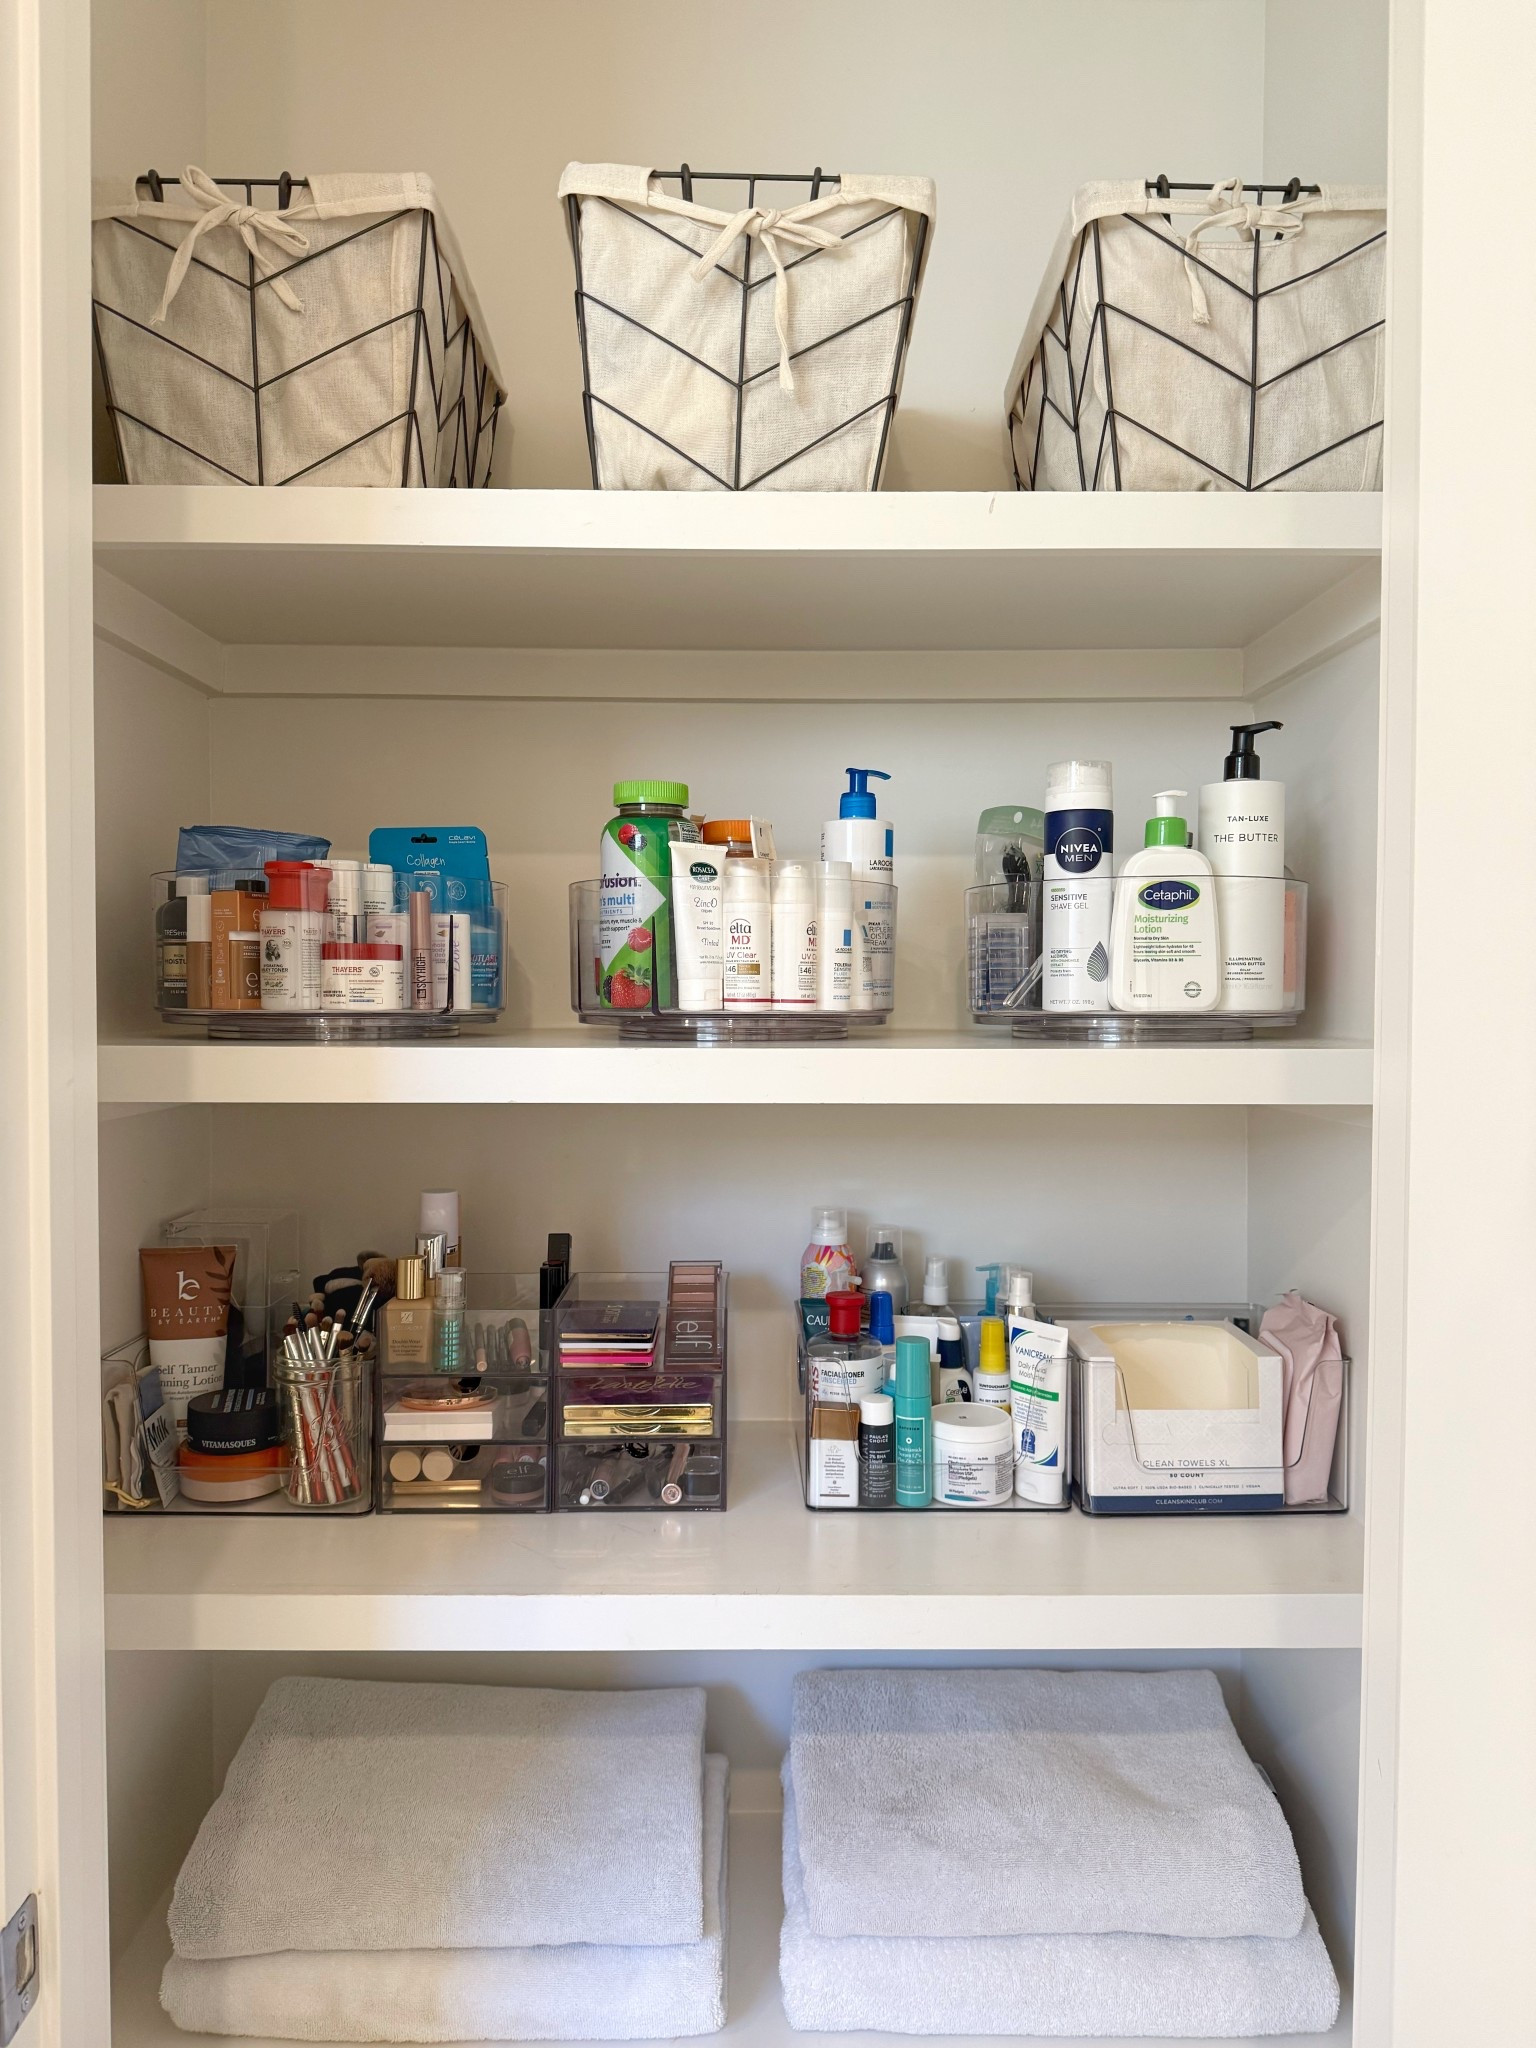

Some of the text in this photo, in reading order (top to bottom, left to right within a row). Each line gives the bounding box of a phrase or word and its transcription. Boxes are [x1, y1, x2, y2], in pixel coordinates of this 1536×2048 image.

[1213, 833, 1279, 843] THE BUTTER
[1060, 843, 1099, 853] NIVEA
[406, 853, 446, 868] Collagen
[1064, 854, 1093, 862] MEN
[607, 893, 635, 906] multi
[1050, 893, 1088, 901] SENSITIVE
[1143, 889, 1194, 902] Cetaphil
[1134, 914, 1189, 925] Moisturizing
[729, 922, 752, 934] elta
[1133, 924, 1162, 933] Lotion
[731, 935, 751, 945] MD
[736, 951, 757, 959] Clear
[150, 1304, 226, 1318] BEAUTY
[1015, 1345, 1053, 1362] VANICREAM
[178, 1364, 218, 1375] Tanner
[820, 1369, 841, 1378] FACIAL
[160, 1377, 190, 1389] nning
[147, 1414, 170, 1451] Milk
[201, 1438, 256, 1448] VITAMASQUES
[1142, 1459, 1230, 1467] CLEAN TOWELS XL
